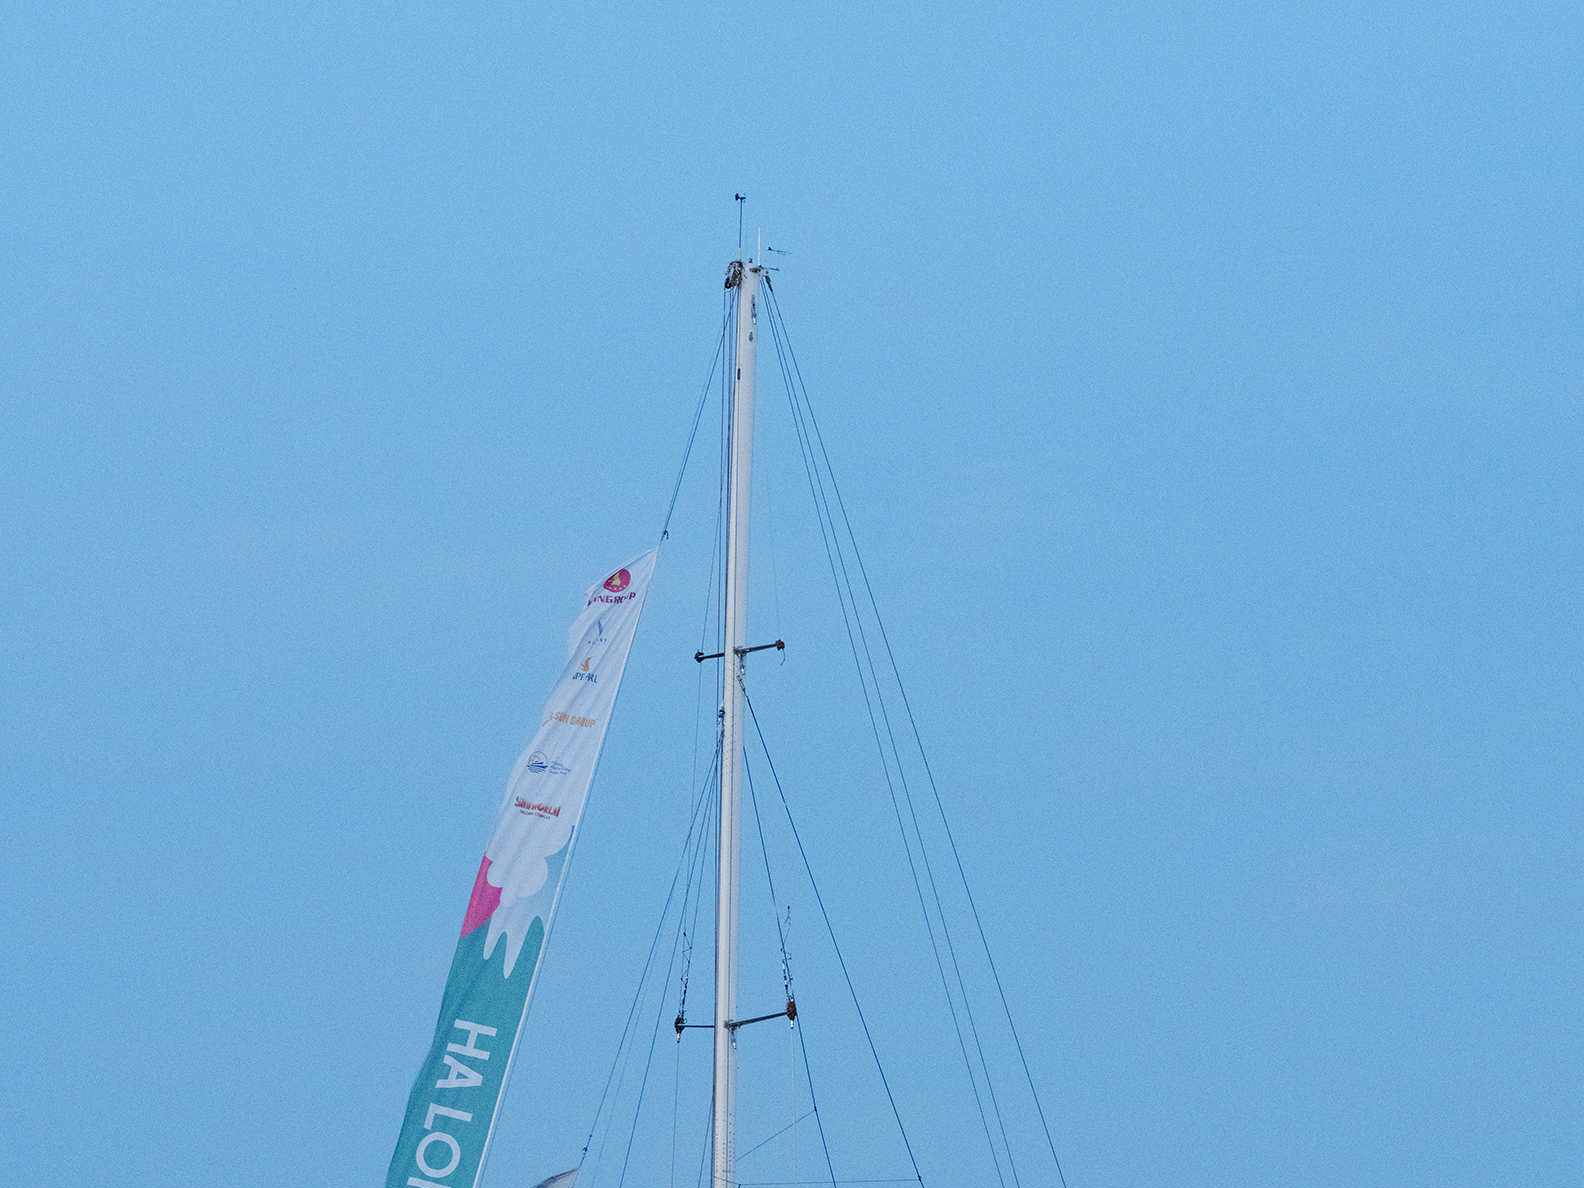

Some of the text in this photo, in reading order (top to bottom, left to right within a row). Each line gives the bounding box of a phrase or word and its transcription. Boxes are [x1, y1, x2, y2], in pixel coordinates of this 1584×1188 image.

[553, 711, 596, 728] SUN GROUP
[435, 1018, 497, 1088] HA
